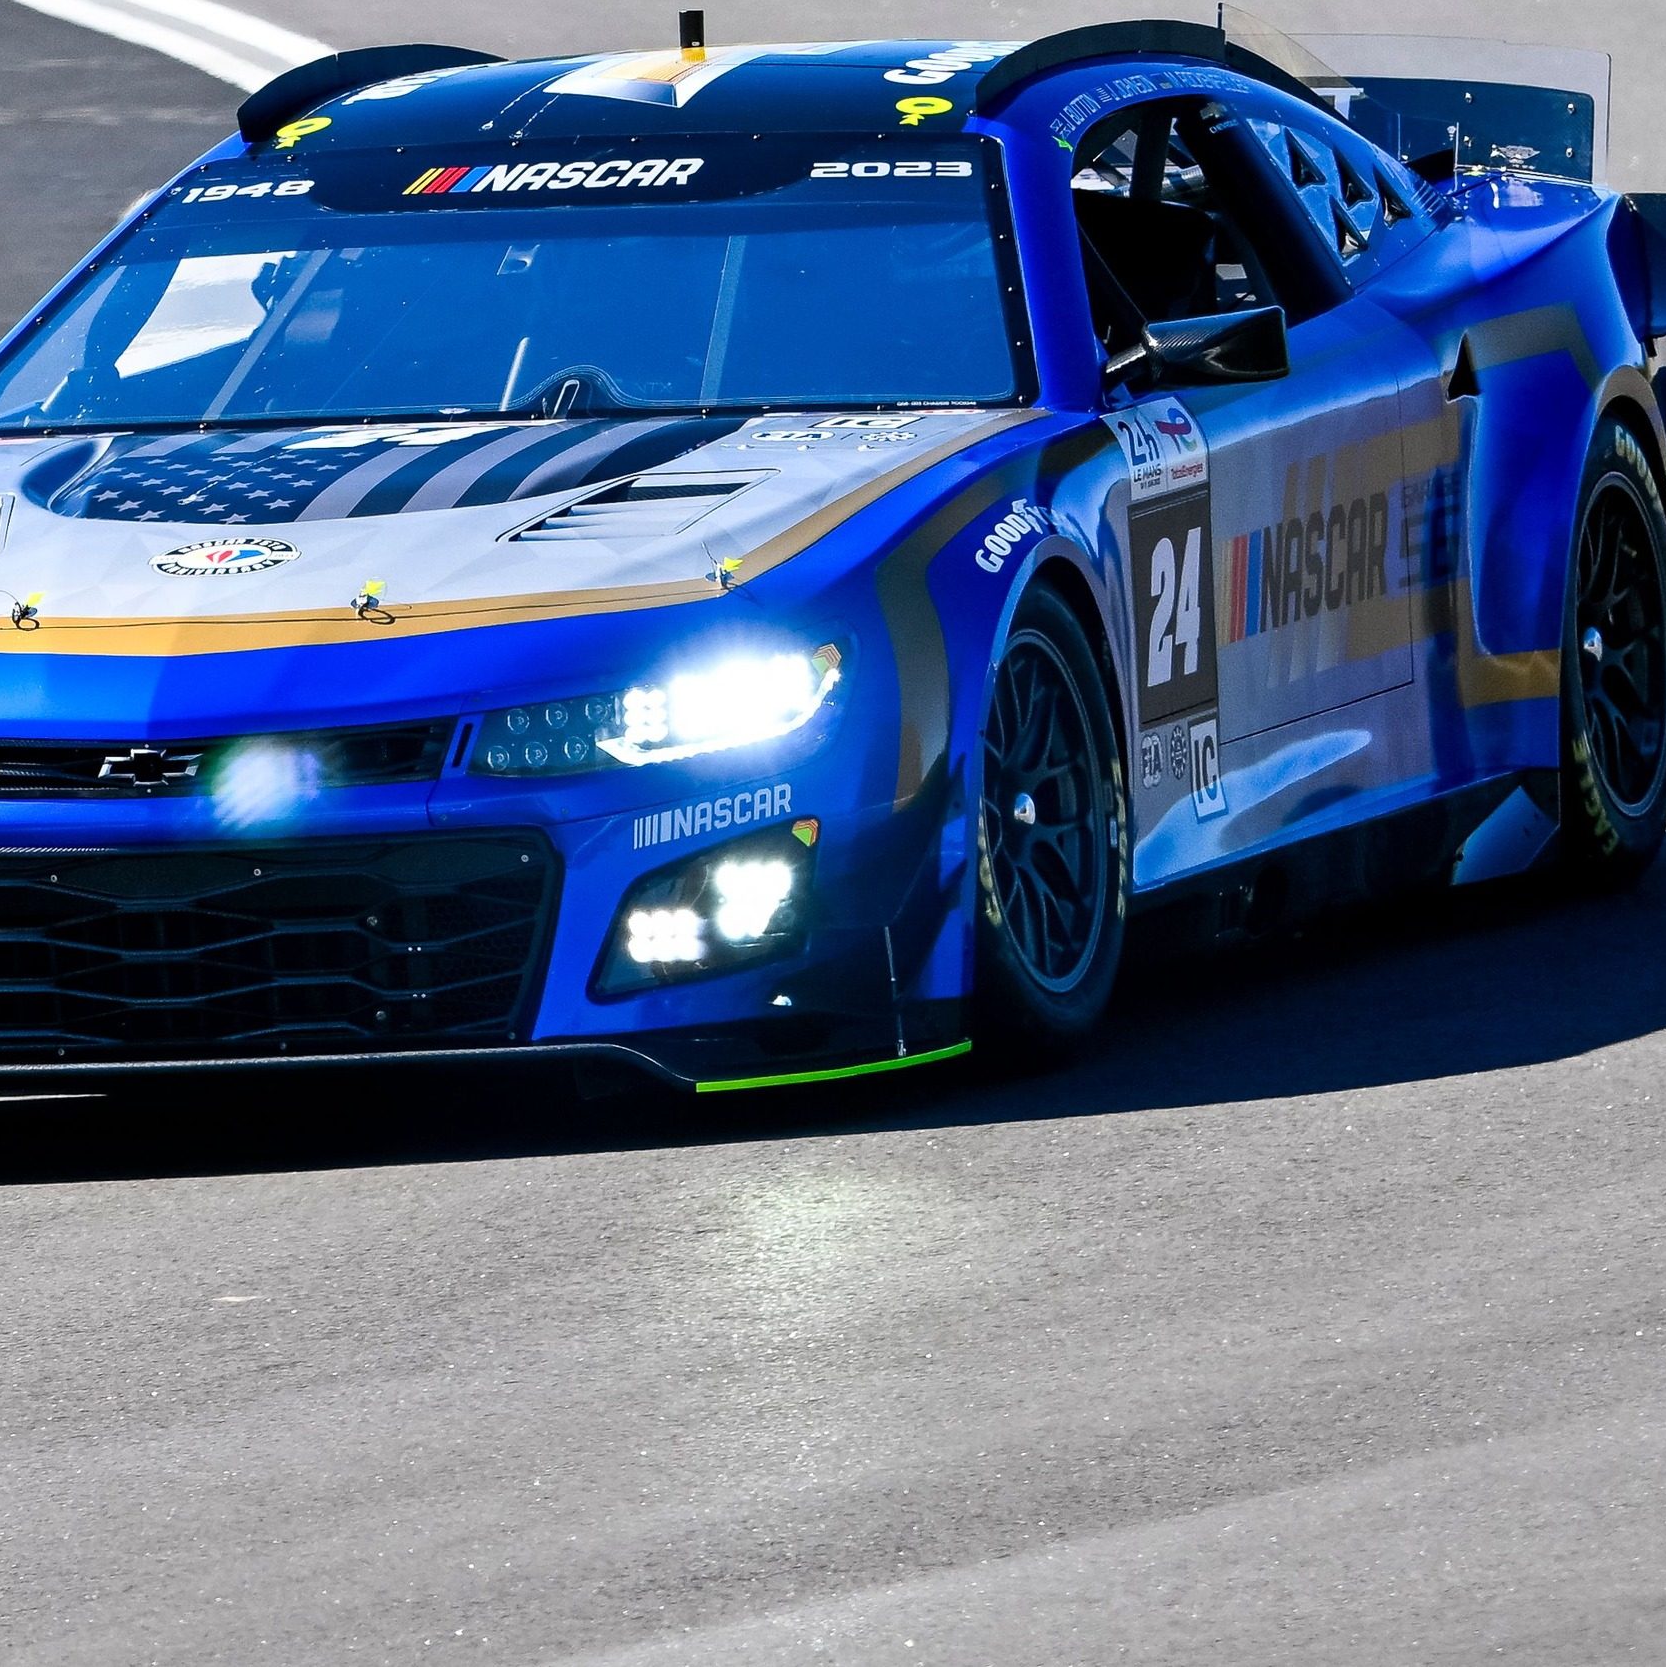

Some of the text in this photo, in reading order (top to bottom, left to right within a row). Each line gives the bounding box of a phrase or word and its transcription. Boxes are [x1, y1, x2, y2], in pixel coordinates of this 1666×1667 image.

[182, 180, 315, 203] 1948
[471, 158, 704, 192] NASCAR
[810, 161, 972, 178] 2023
[1118, 416, 1160, 466] 24h
[1260, 491, 1389, 633] NASCAR
[1147, 527, 1201, 687] 24
[1194, 736, 1217, 803] IC
[673, 783, 791, 839] NASCAR
